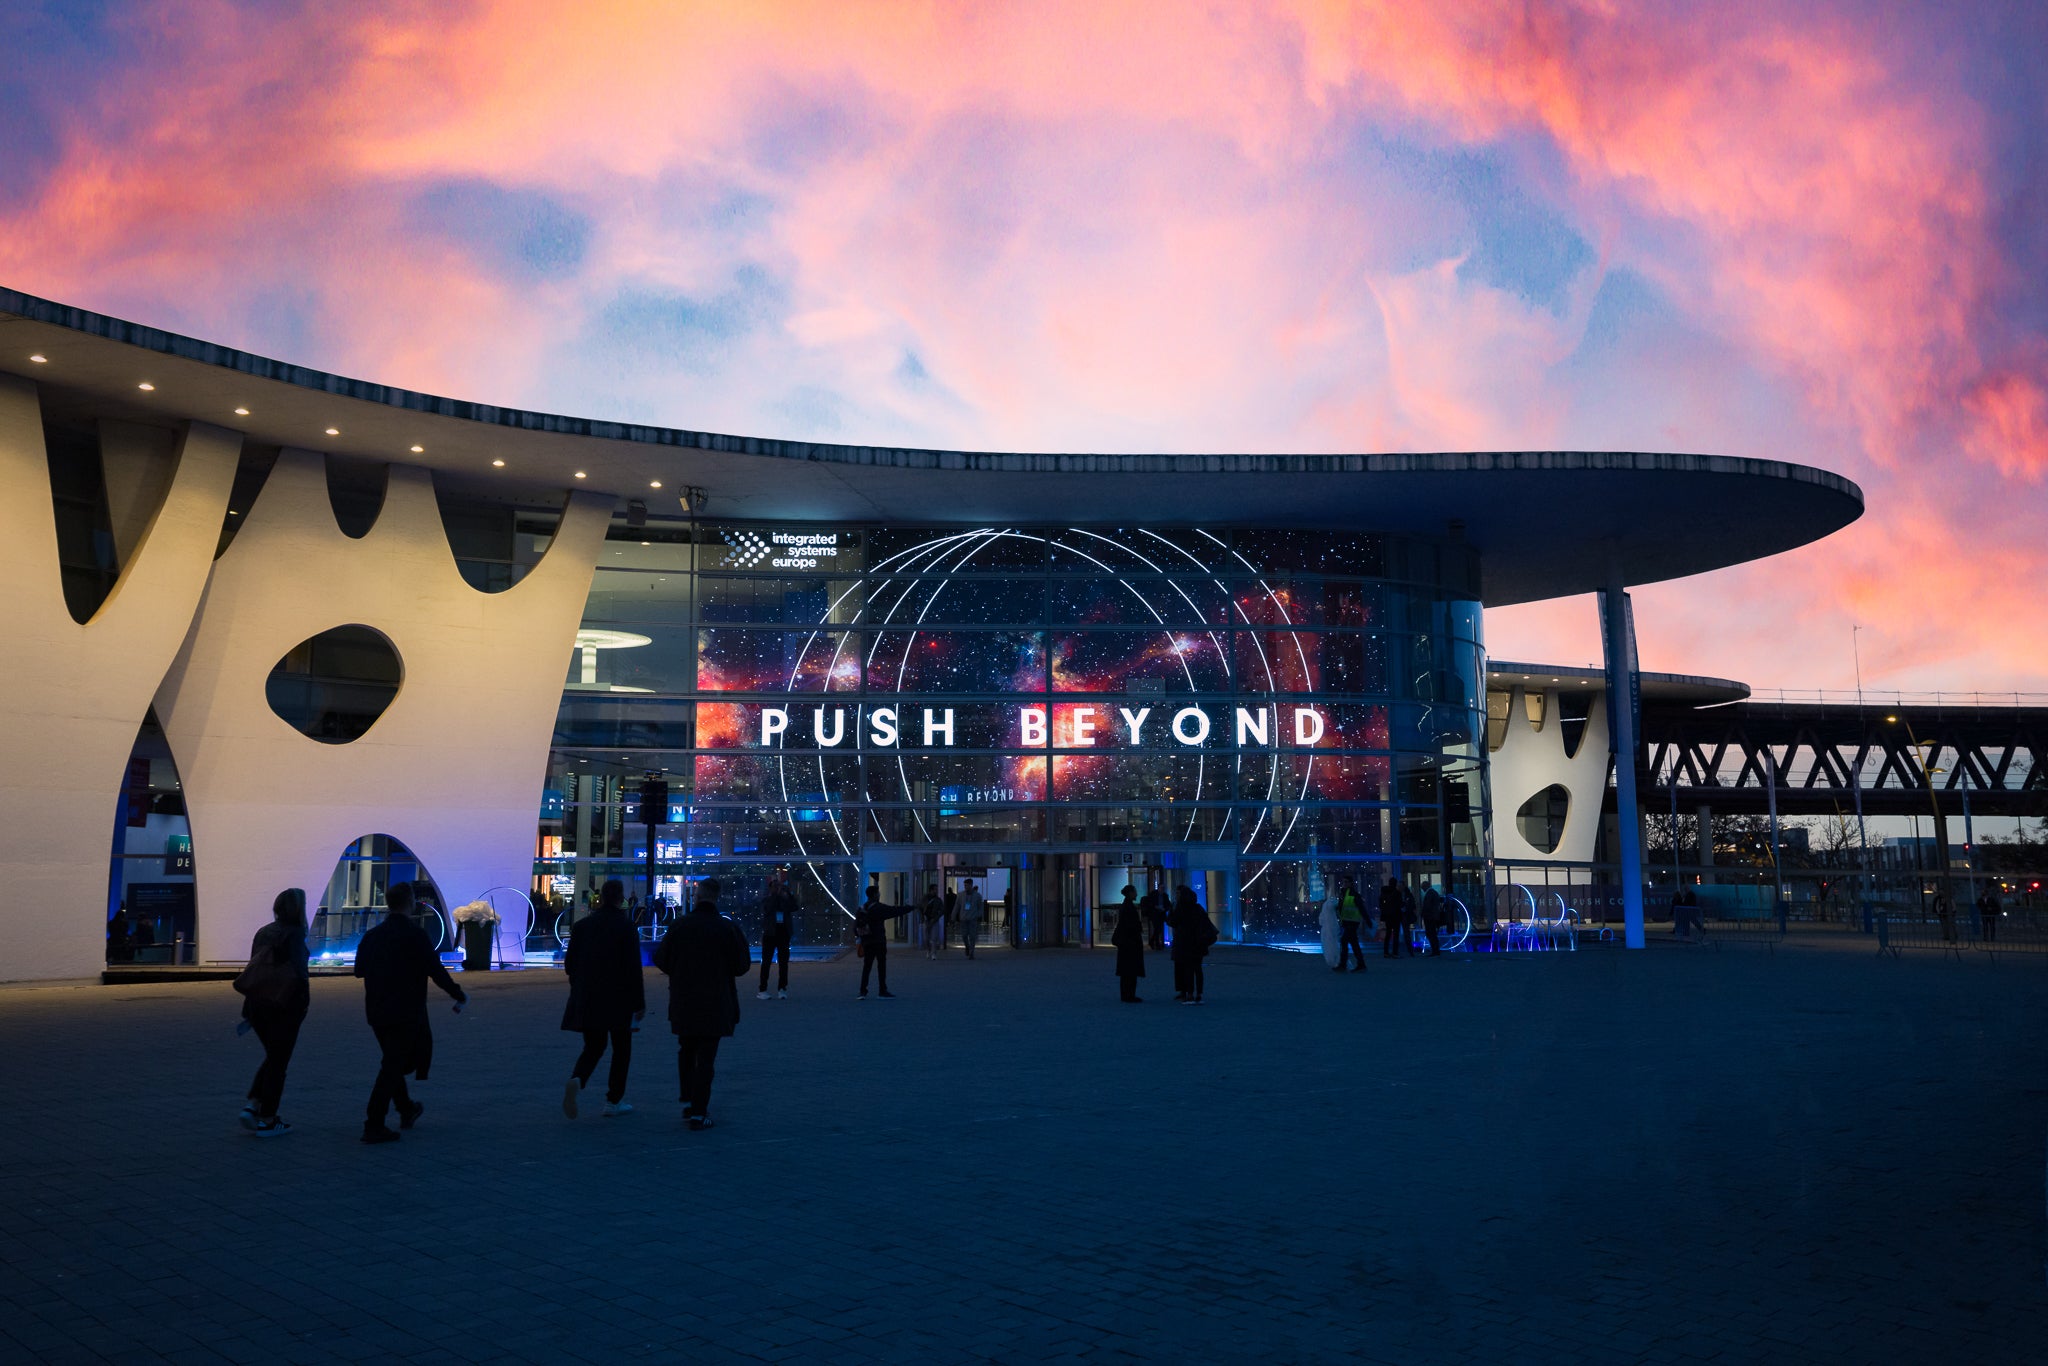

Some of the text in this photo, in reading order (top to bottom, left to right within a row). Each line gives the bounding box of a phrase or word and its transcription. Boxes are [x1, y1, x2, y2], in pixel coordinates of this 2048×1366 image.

[772, 532, 837, 546] integrated
[788, 546, 837, 557] systems
[772, 558, 816, 569] europe
[761, 707, 1324, 747] PUSH BEYOND
